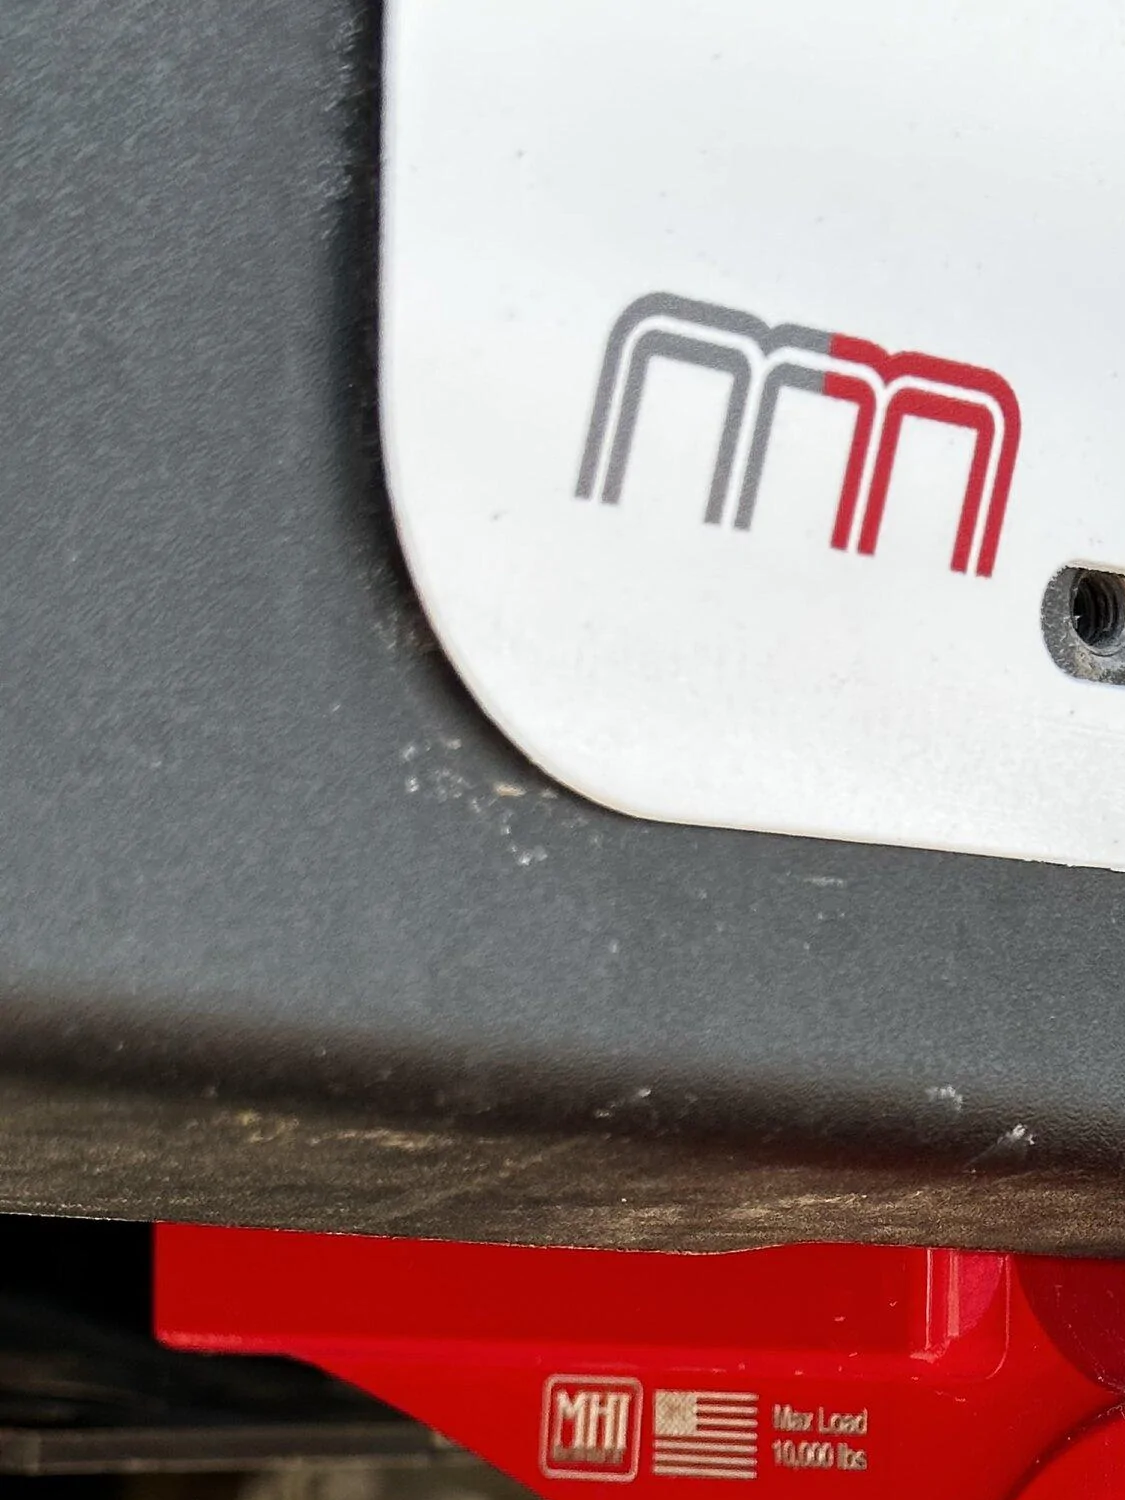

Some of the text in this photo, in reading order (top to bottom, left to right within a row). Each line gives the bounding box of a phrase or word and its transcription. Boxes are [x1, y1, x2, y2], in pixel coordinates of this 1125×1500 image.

[772, 1403, 868, 1435] Max Load
[770, 1438, 868, 1471] 10,000 lbs
